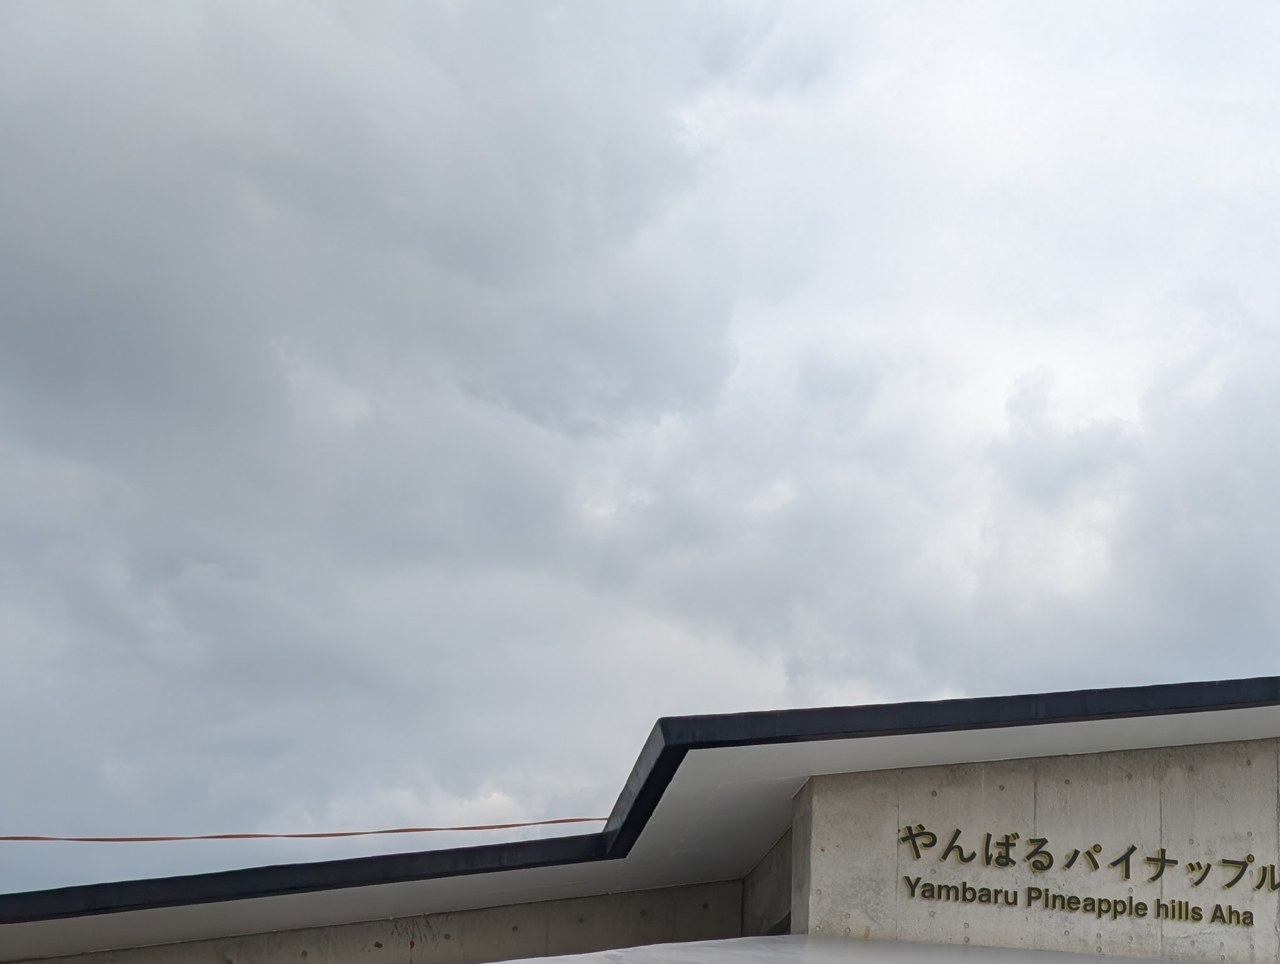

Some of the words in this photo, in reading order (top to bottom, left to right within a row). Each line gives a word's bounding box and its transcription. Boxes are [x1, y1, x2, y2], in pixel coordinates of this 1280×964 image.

[902, 876, 1018, 906] Yambaru
[1027, 888, 1149, 919] Pineapple
[1155, 901, 1204, 923] hills
[1211, 903, 1255, 927] Aha
